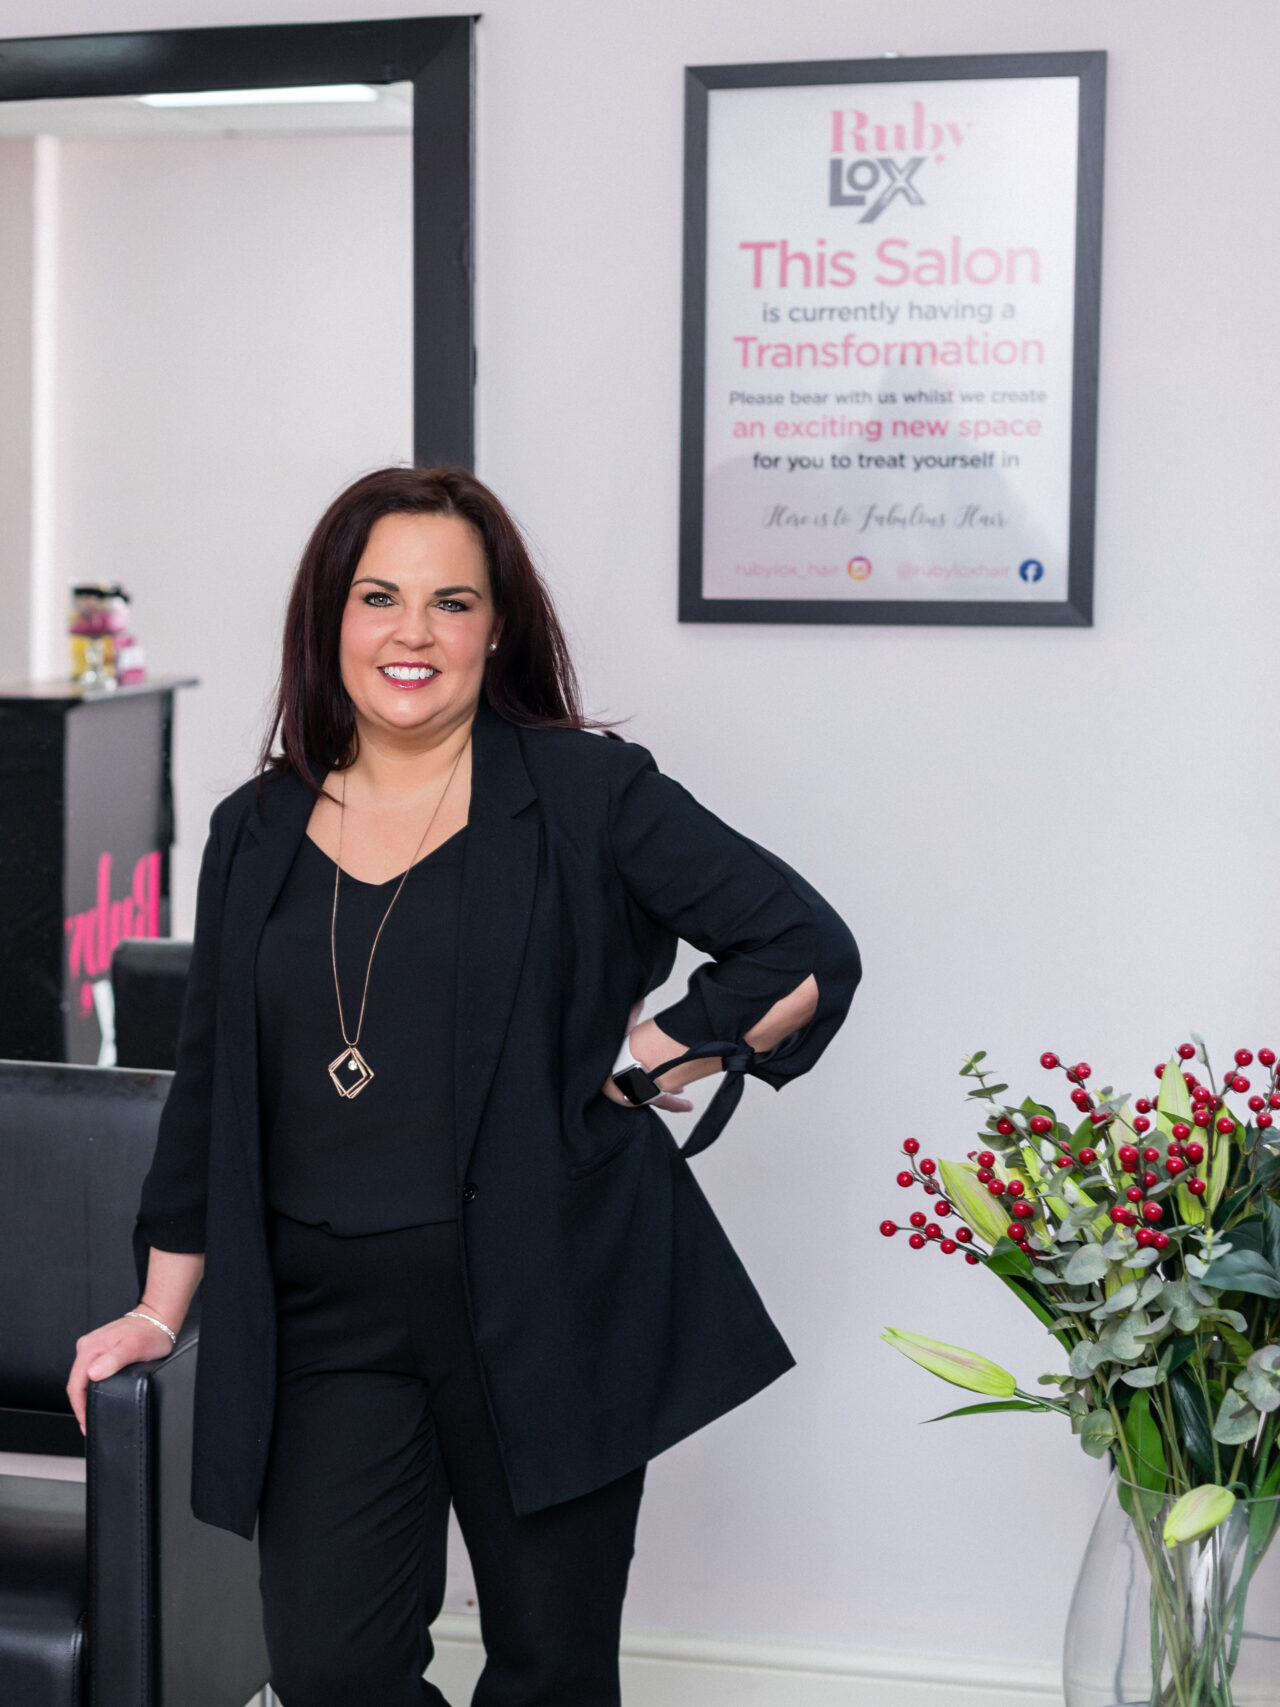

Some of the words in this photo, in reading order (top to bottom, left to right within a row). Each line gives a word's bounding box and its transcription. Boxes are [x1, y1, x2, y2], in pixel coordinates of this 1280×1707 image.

[830, 101, 972, 165] Ruby
[738, 238, 857, 289] This
[874, 234, 1041, 287] Salon
[762, 302, 781, 322] is
[789, 301, 900, 325] currently
[908, 299, 993, 324] having
[1001, 304, 1017, 320] a
[733, 332, 1045, 368] Transformation
[729, 390, 785, 406] Please
[790, 390, 828, 405] bear
[835, 389, 872, 405] with
[877, 392, 897, 405] us
[904, 388, 954, 405] whilst
[959, 391, 987, 404] we
[990, 388, 1048, 404] create
[732, 419, 765, 439] an
[774, 415, 883, 442] exciting
[891, 417, 951, 438] new
[958, 417, 1043, 441] space
[752, 452, 780, 470] for
[787, 455, 825, 472] you
[831, 453, 852, 470] to
[858, 452, 905, 469] treat
[913, 451, 996, 471] yourself
[1000, 452, 1021, 468] in
